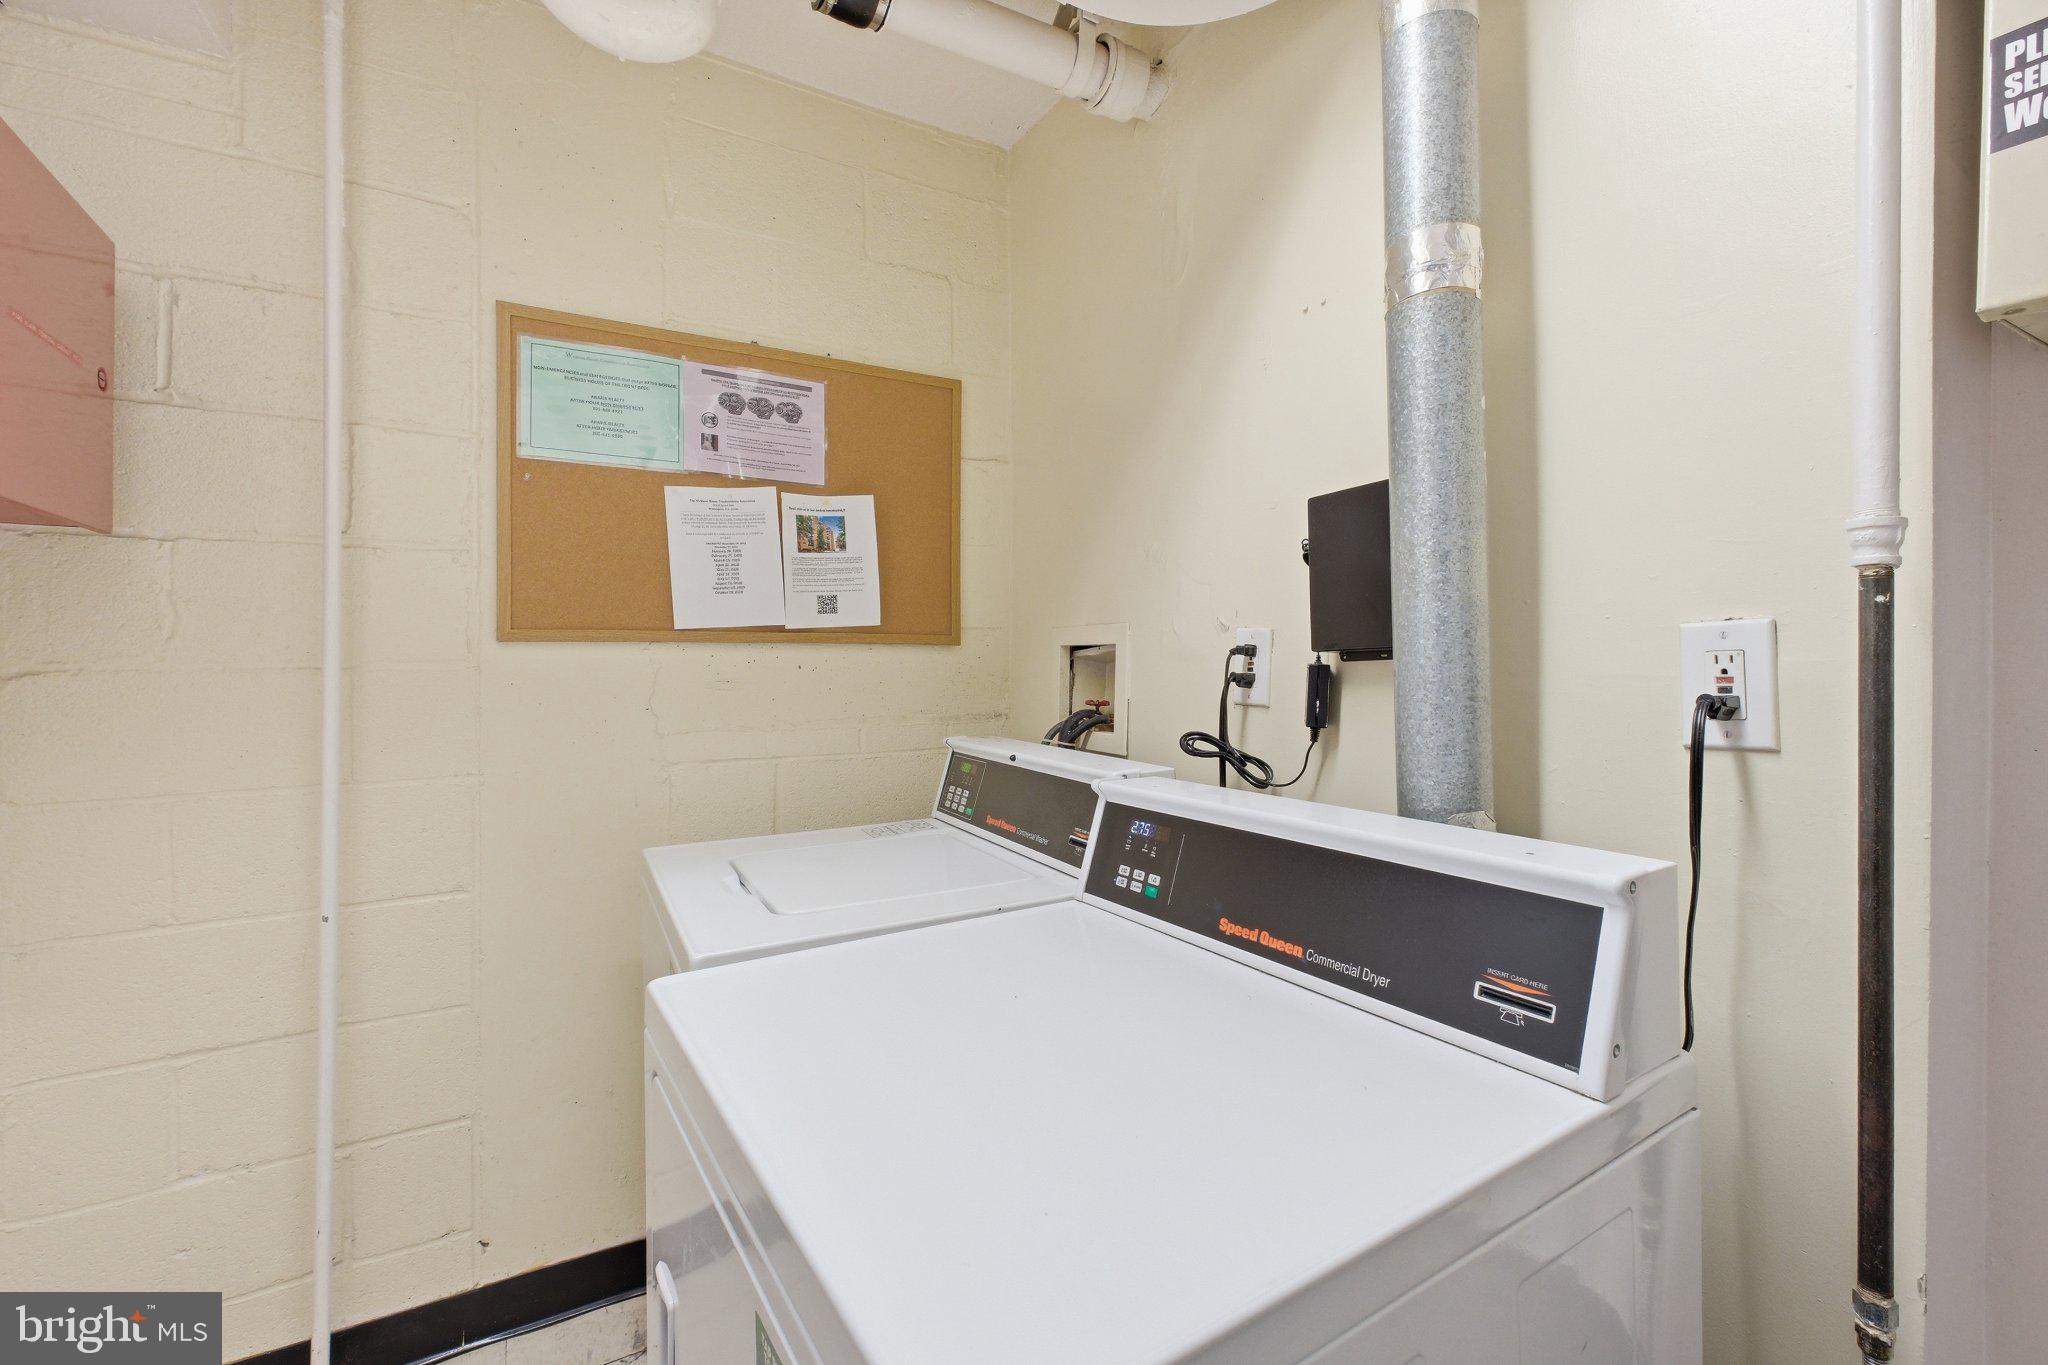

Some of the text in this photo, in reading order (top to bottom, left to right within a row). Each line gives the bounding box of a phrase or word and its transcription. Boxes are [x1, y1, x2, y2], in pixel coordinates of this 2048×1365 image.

[1218, 917, 1391, 988] Speed Queen Commercial Dryer
[1487, 967, 1549, 991] INSERT CARD HERE
